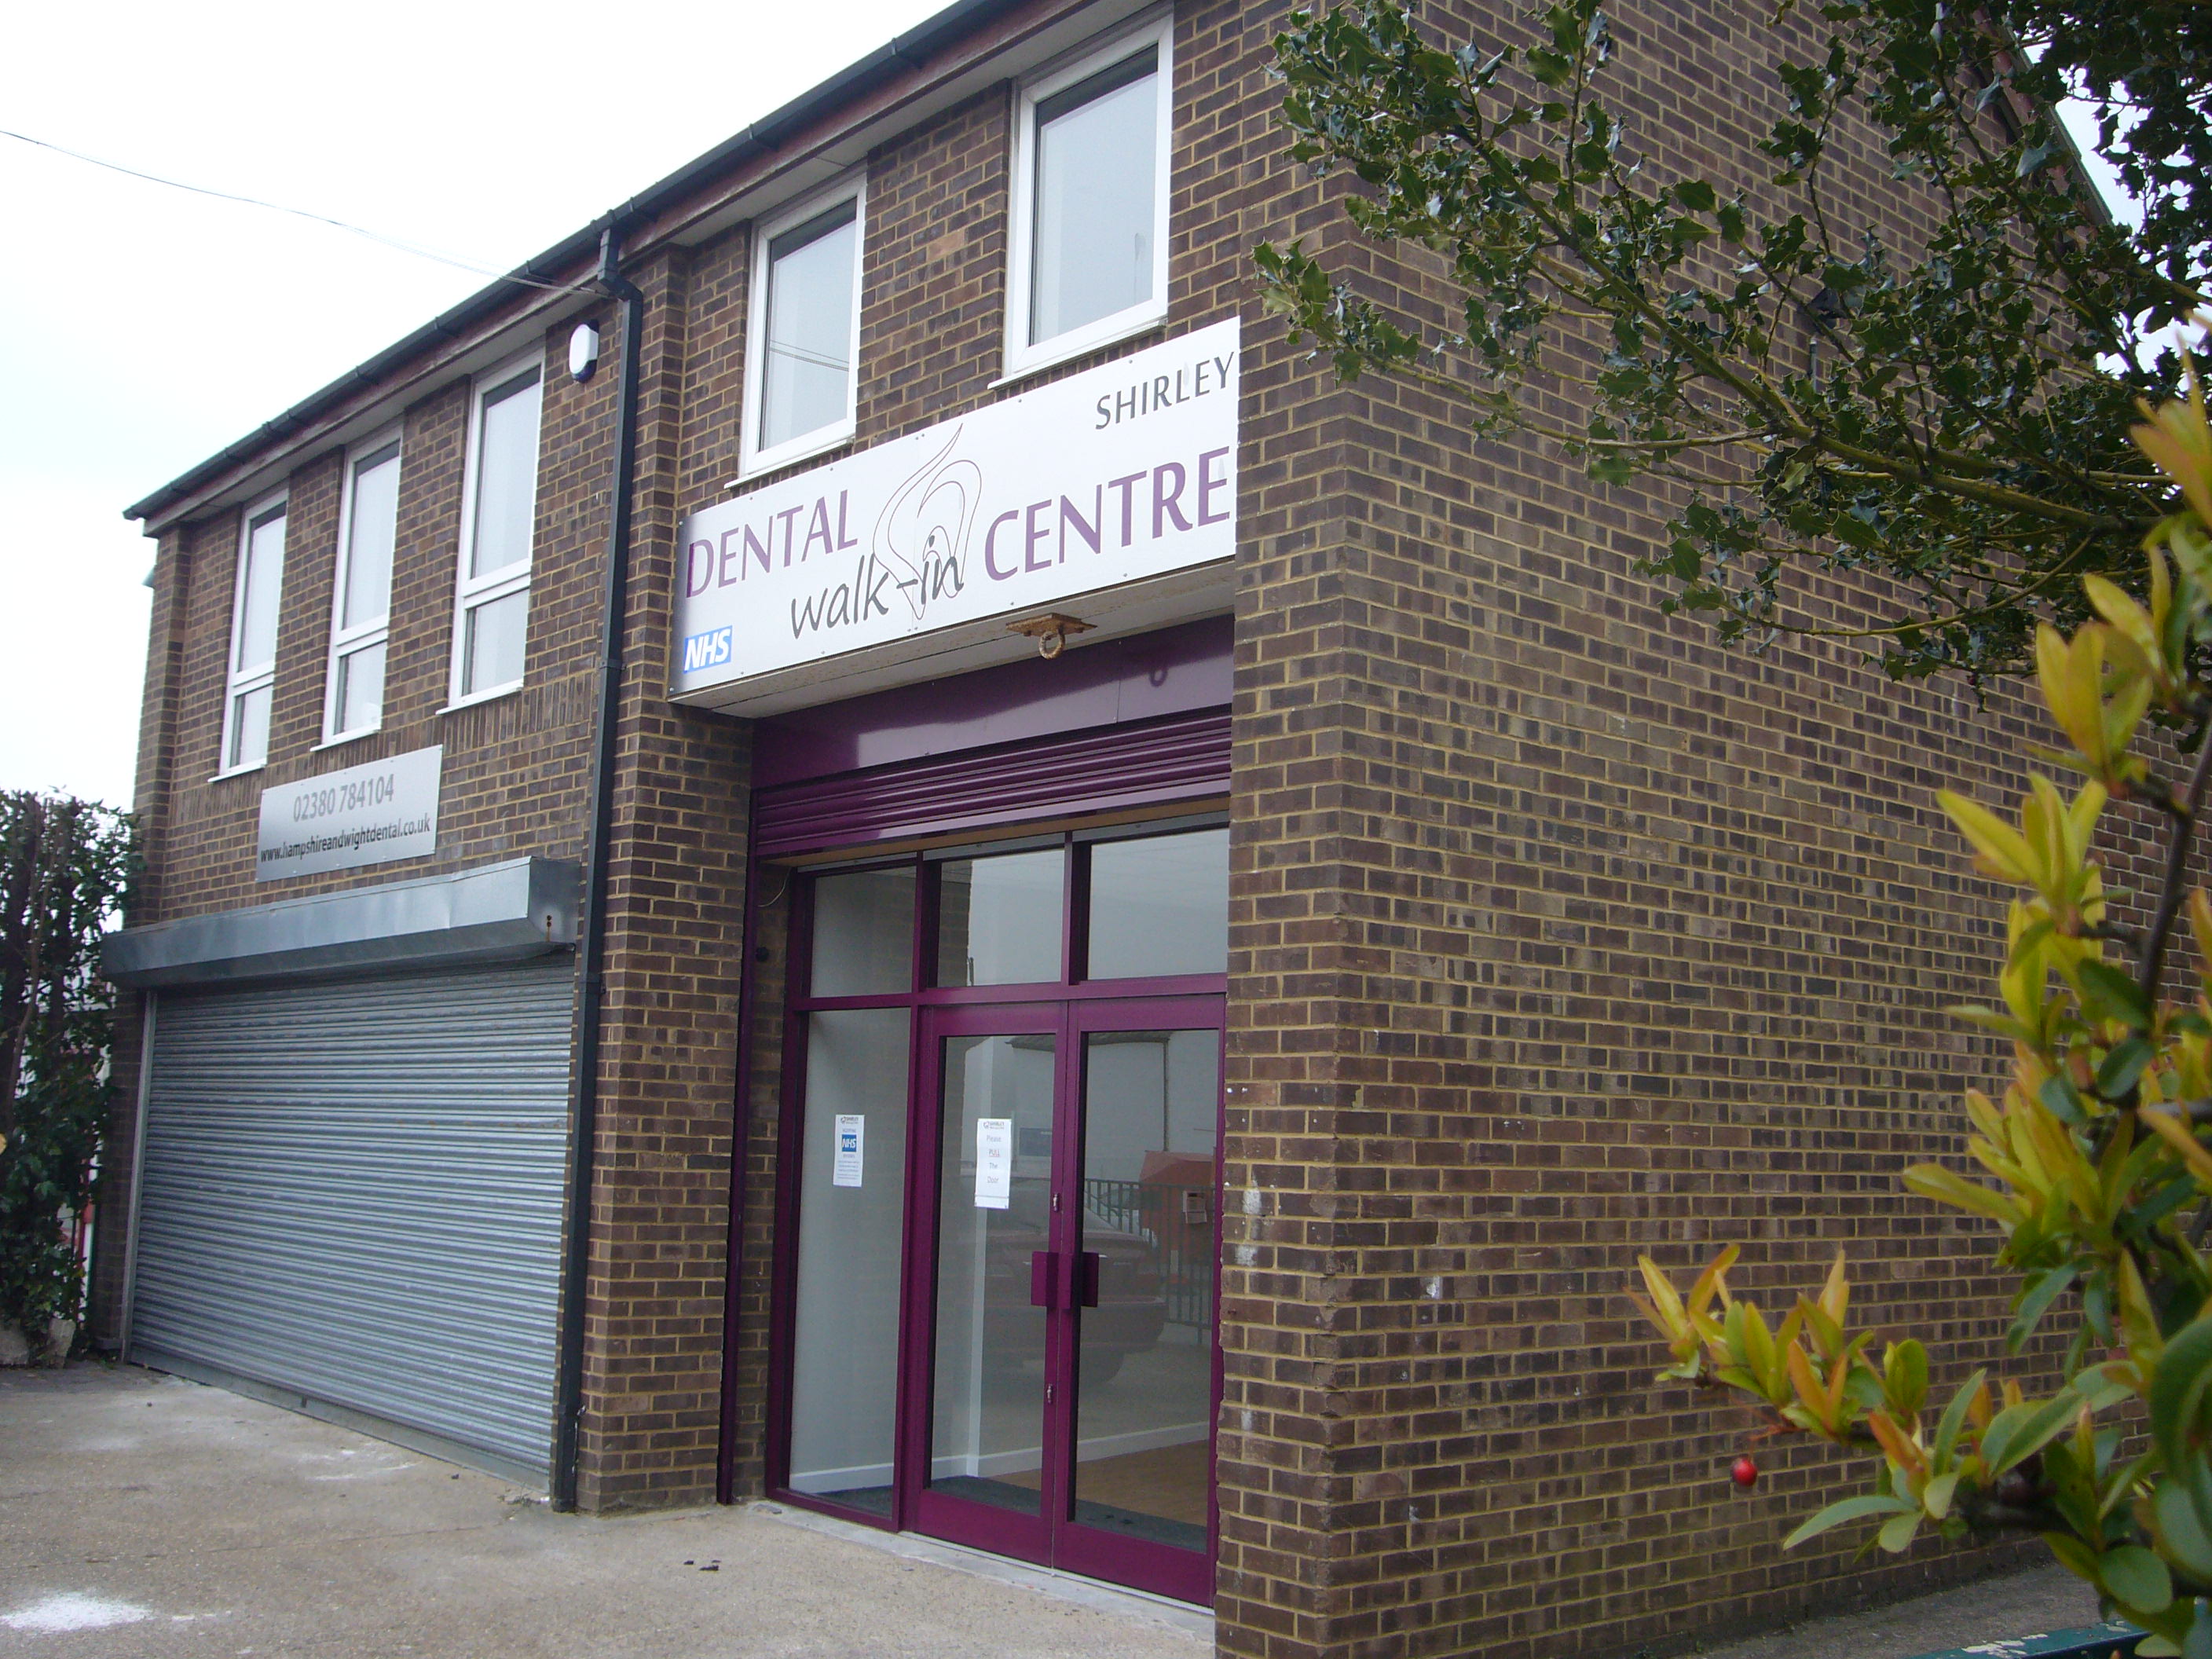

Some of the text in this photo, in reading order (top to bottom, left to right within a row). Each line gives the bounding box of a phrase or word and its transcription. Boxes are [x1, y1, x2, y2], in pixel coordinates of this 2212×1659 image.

[1095, 351, 1234, 430] SHIRLEY
[686, 445, 1230, 598] DENTAL CENTRE
[791, 536, 965, 639] walk-in
[683, 632, 731, 672] NHS
[293, 773, 394, 822] 02380 784104
[260, 813, 430, 862] www.hampshireandwightdental.co.uk
[842, 1137, 856, 1148] NHS
